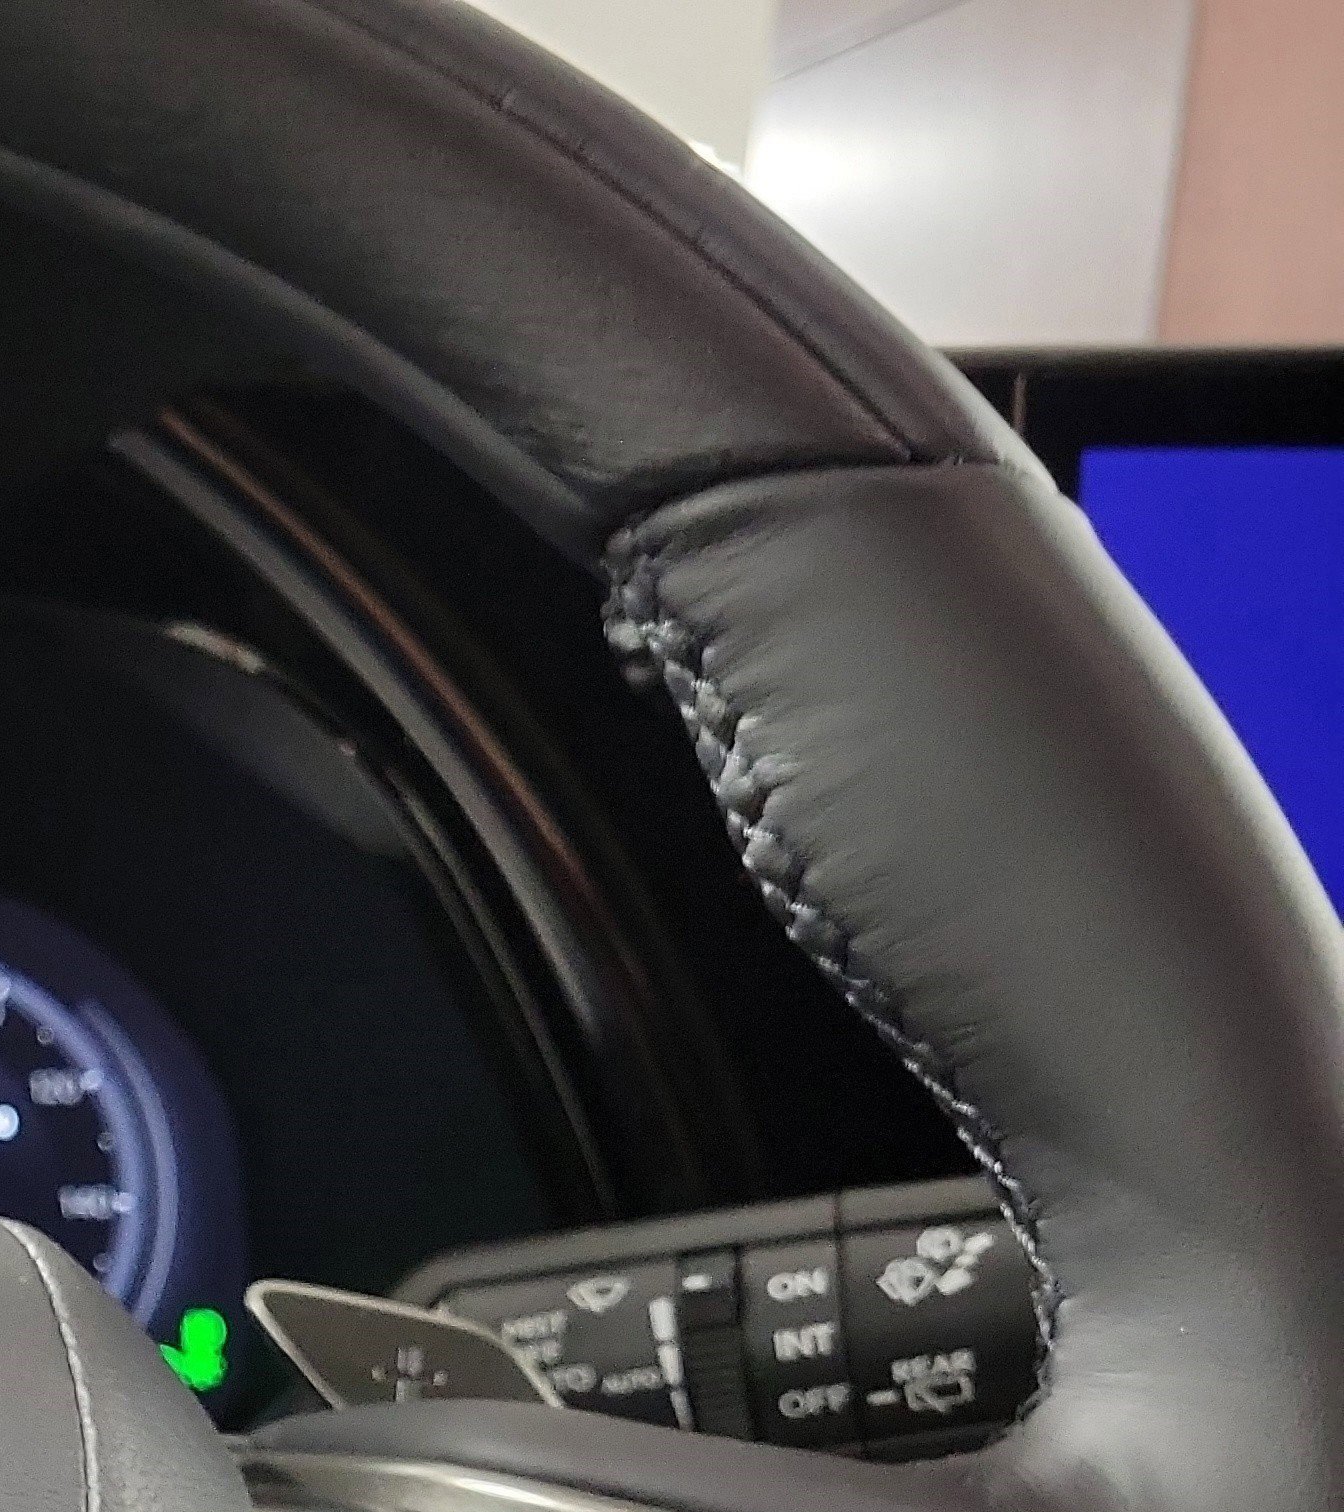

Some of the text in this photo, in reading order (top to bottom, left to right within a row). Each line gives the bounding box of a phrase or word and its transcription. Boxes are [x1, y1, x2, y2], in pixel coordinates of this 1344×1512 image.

[767, 1266, 830, 1301] ON
[773, 1322, 836, 1361] INT
[778, 1381, 850, 1420] OFF
